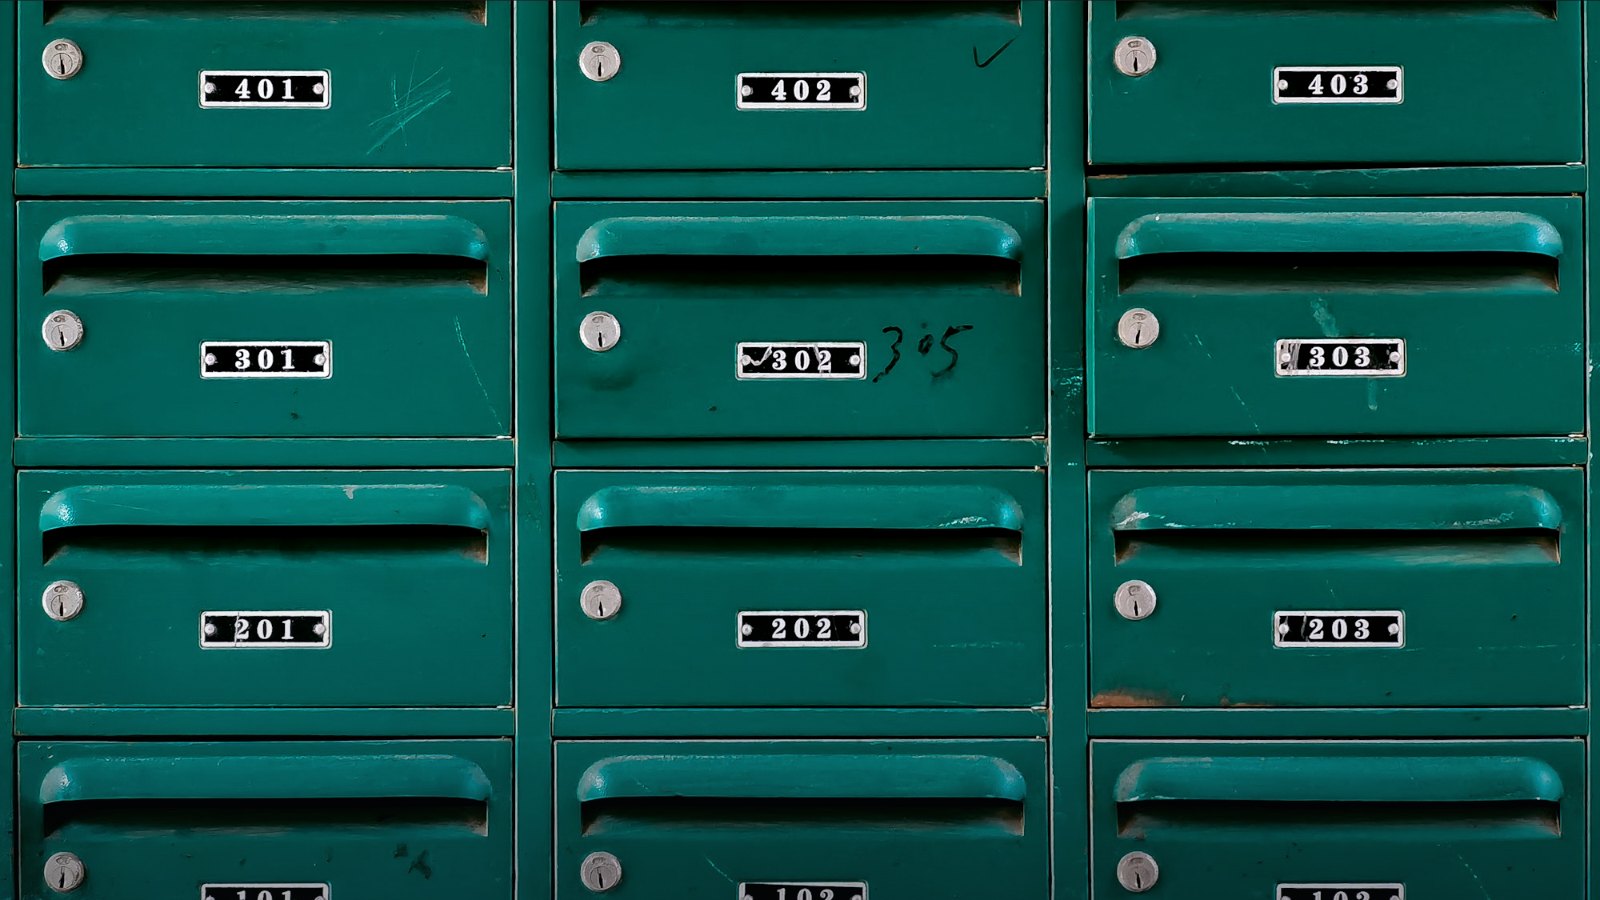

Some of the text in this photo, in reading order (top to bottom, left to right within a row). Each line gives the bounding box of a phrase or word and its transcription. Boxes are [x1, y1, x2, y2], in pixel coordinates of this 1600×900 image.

[234, 78, 295, 100] 401
[770, 79, 831, 101] 402
[1307, 73, 1369, 95] 403
[234, 348, 296, 370] 301
[771, 349, 832, 371] 302
[1308, 345, 1371, 368] 303
[234, 618, 295, 640] 201
[771, 617, 832, 639] 202
[1308, 618, 1370, 640] 203
